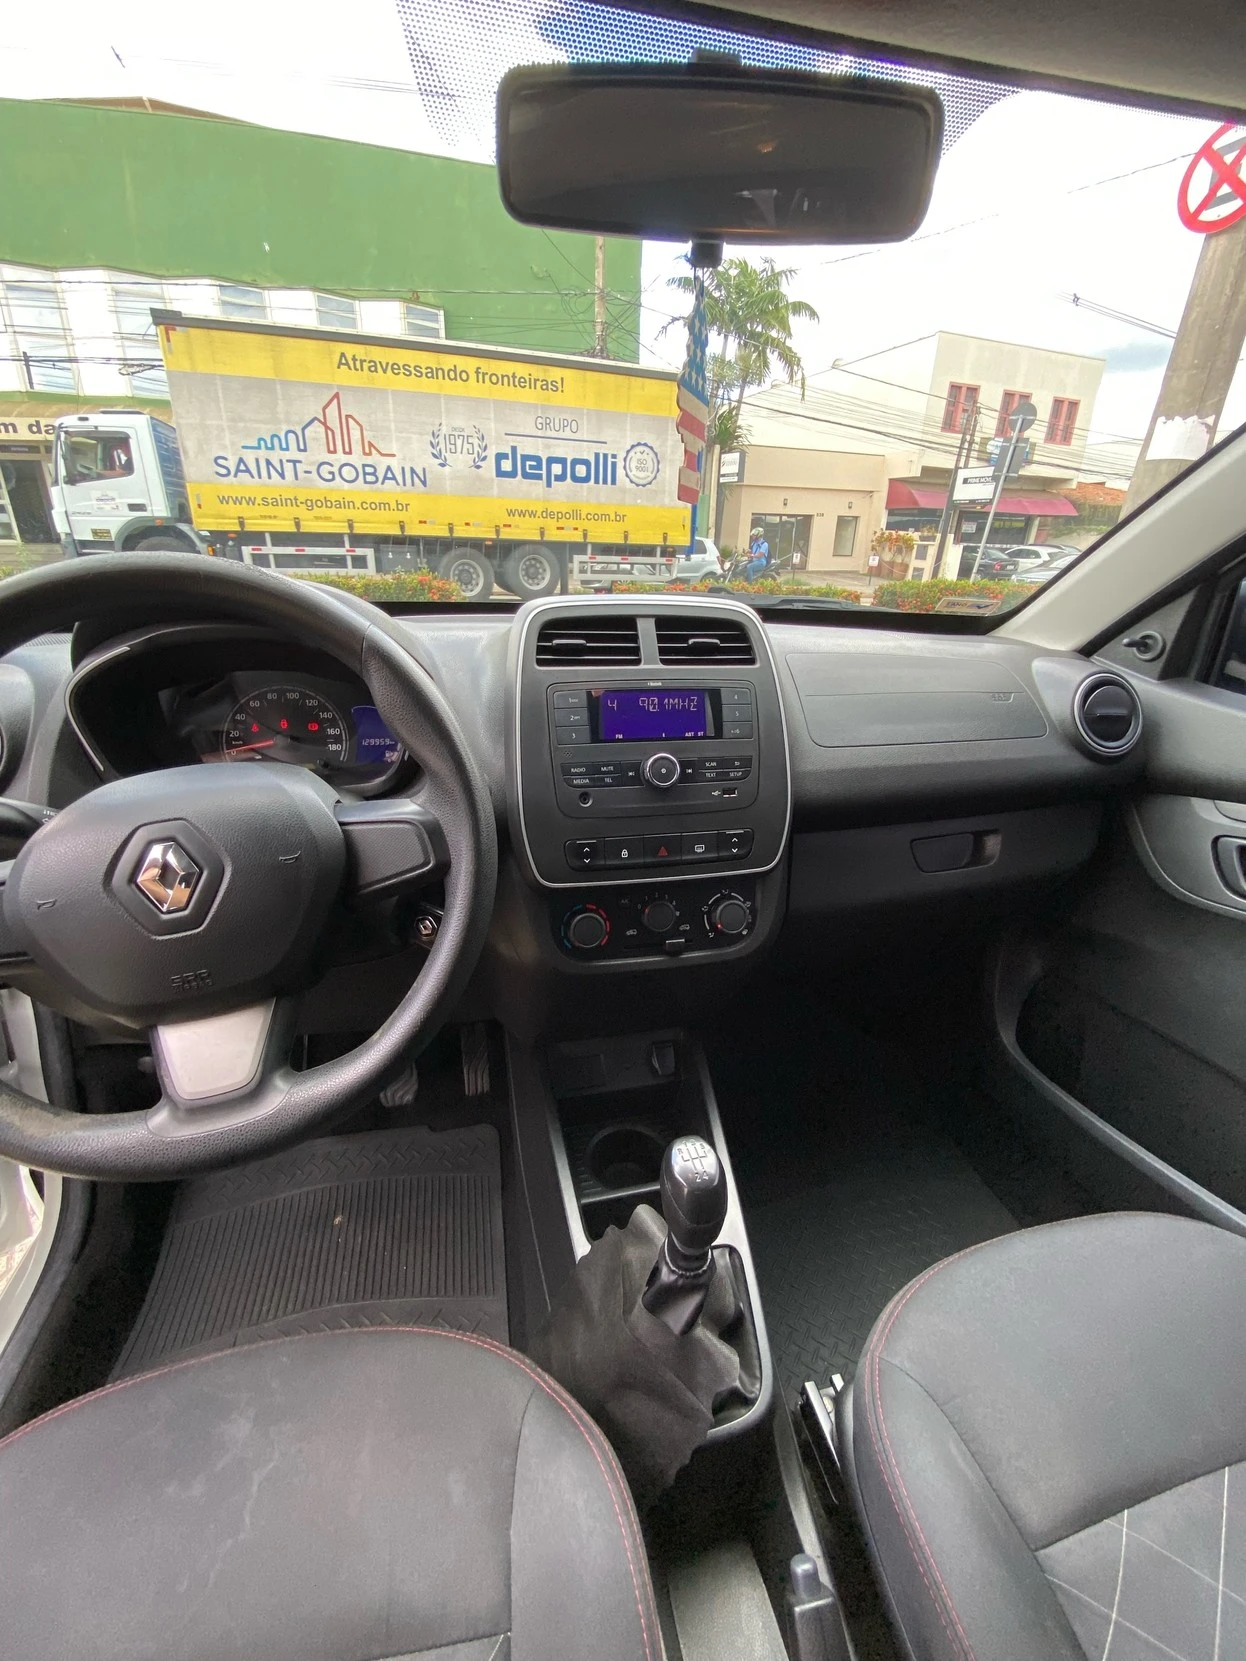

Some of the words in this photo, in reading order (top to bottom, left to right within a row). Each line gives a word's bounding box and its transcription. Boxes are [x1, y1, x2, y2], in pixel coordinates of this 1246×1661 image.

[337, 352, 470, 383] Atravessando
[475, 367, 565, 393] fronteiras!
[535, 416, 579, 434] GRUPO
[444, 433, 475, 455] 1975
[494, 445, 618, 488] depolli
[636, 458, 648, 466] ISO
[213, 455, 428, 488] SAINT-GOBAIN
[217, 494, 410, 512] www.saint-gobain.com.br
[506, 508, 627, 523] www.depolli.com.br
[267, 692, 278, 700] 80
[286, 692, 300, 700] 100
[305, 699, 319, 707] 120
[608, 699, 617, 711] 4
[235, 713, 246, 721] 40
[362, 738, 390, 746] 129959
